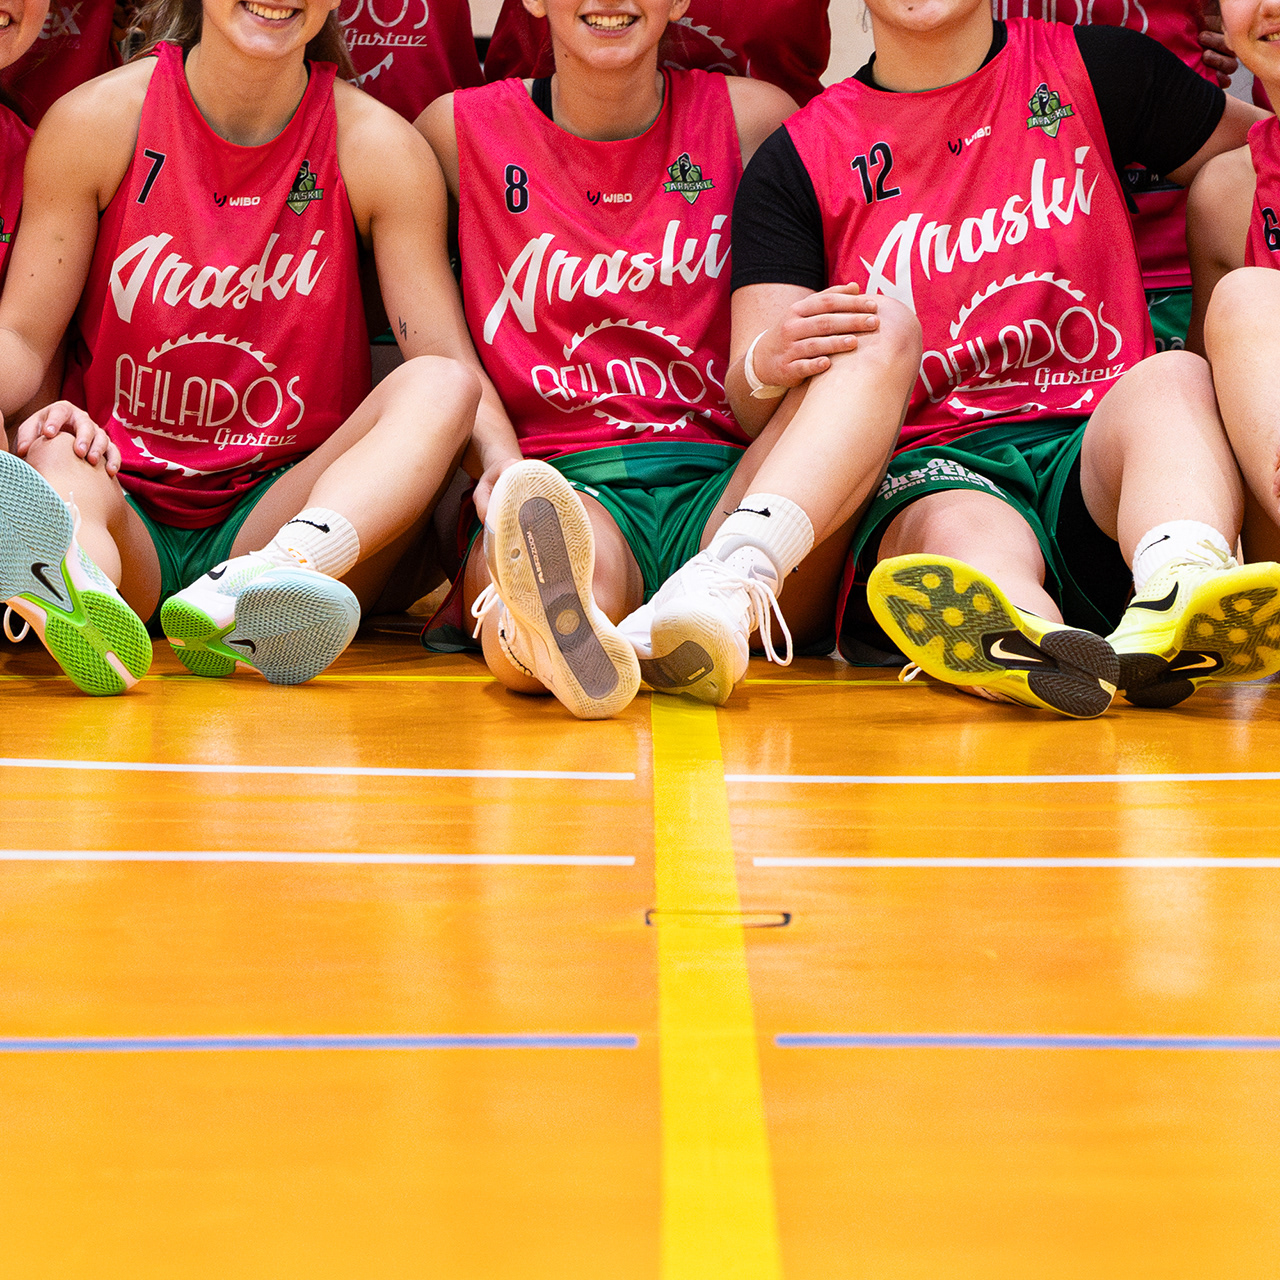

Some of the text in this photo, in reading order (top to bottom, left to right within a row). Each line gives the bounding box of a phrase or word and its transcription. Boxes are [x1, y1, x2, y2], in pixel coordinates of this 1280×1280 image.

[964, 125, 992, 147] WIBO
[136, 149, 166, 205] 7
[229, 195, 261, 207] WIBO
[287, 190, 319, 201] RASKI
[504, 163, 529, 214] 8
[603, 193, 633, 203] WIBO
[850, 141, 902, 205] 12
[859, 146, 1100, 315] Araski
[109, 229, 329, 324] Araski
[483, 214, 732, 346] Araski
[114, 353, 306, 431] AFILADOS
